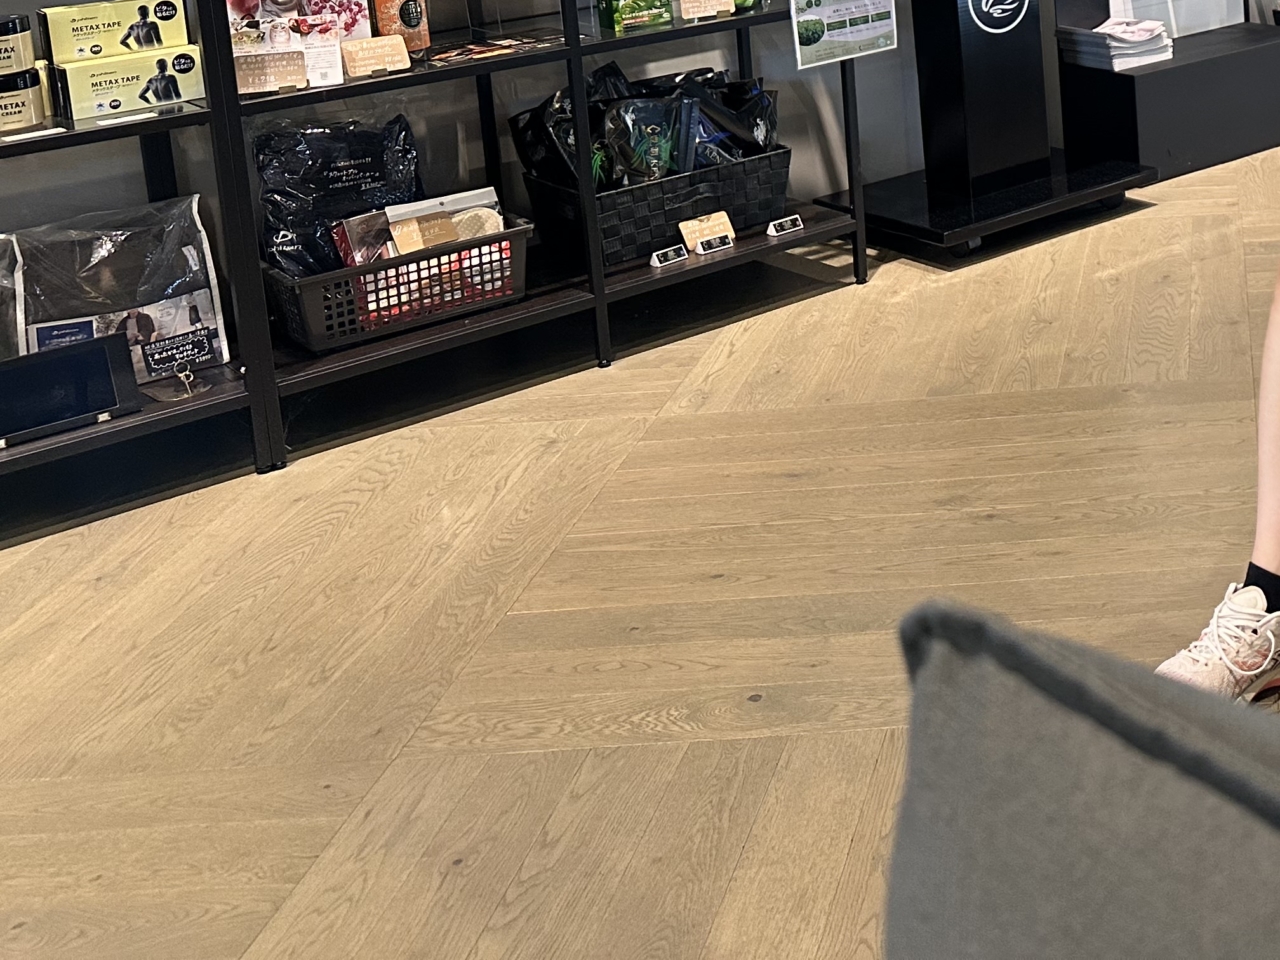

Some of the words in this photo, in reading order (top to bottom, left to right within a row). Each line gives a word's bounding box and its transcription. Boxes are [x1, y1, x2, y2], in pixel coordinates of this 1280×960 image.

[71, 23, 100, 34] METAX
[102, 21, 122, 30] TAPE
[91, 78, 119, 89] METAX
[121, 74, 141, 84] TAPE
[1, 109, 23, 117] CREAM
